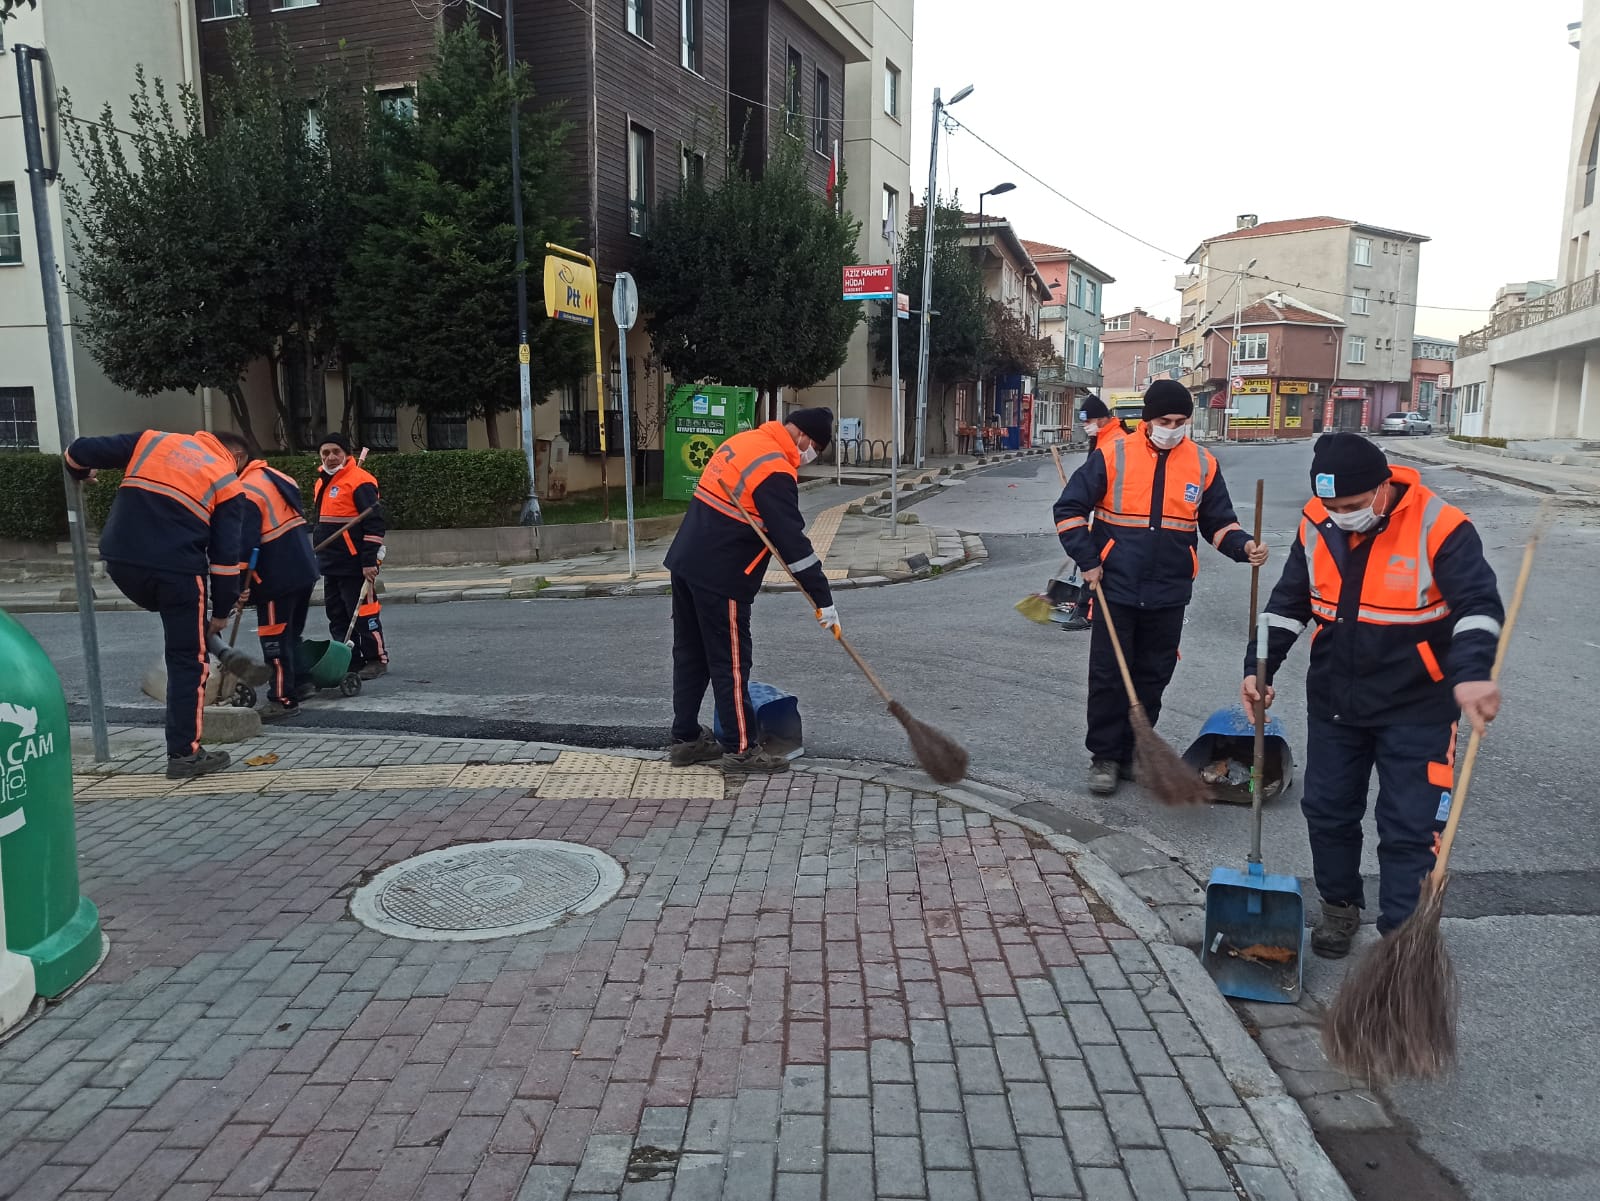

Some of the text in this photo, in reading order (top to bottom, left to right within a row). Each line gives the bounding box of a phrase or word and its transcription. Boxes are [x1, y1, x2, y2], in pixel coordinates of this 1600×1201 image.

[846, 269, 860, 277] AZİZ
[845, 278, 864, 286] HÜDAİ
[566, 285, 580, 308] Ptt
[7, 732, 54, 765] CAM
